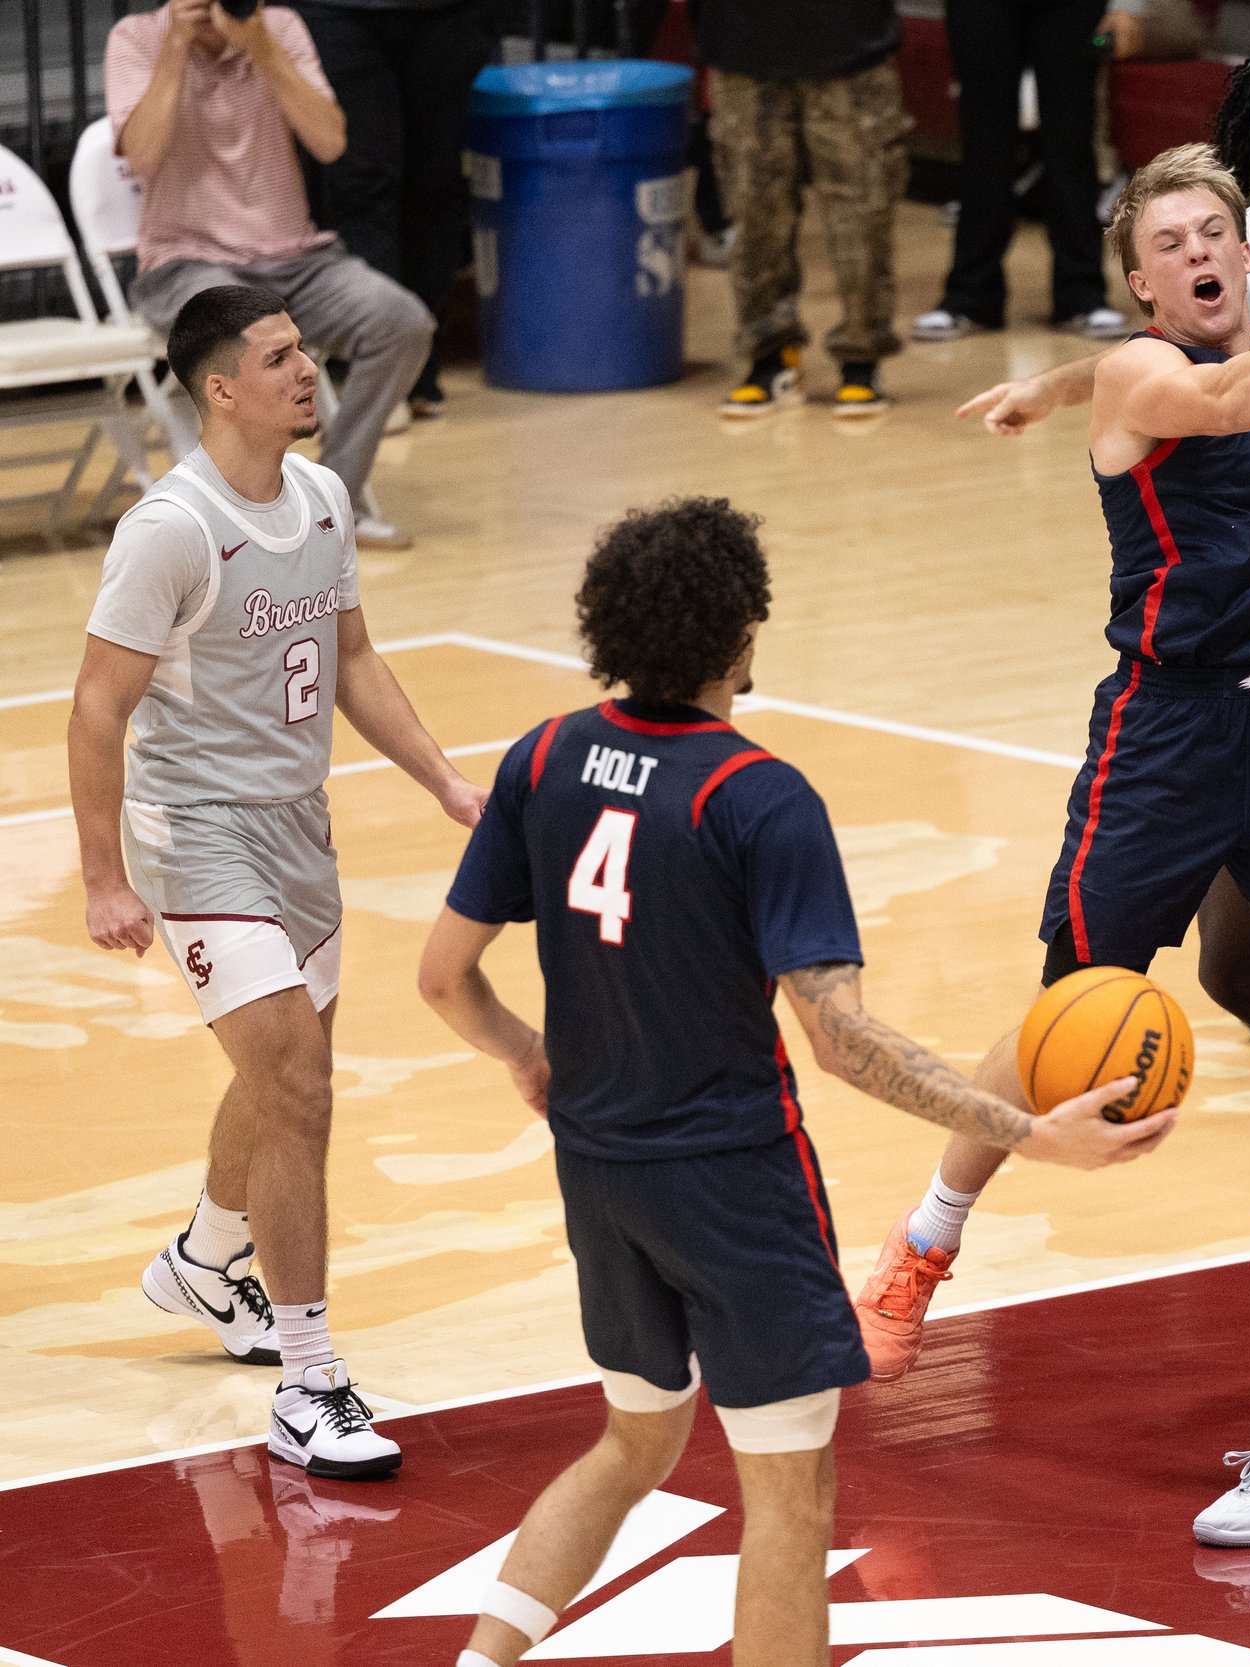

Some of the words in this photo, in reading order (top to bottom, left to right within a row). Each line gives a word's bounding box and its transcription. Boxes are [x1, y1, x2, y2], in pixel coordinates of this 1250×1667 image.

[284, 637, 320, 726] 2
[580, 743, 659, 796] HOLT
[567, 805, 639, 947] 4
